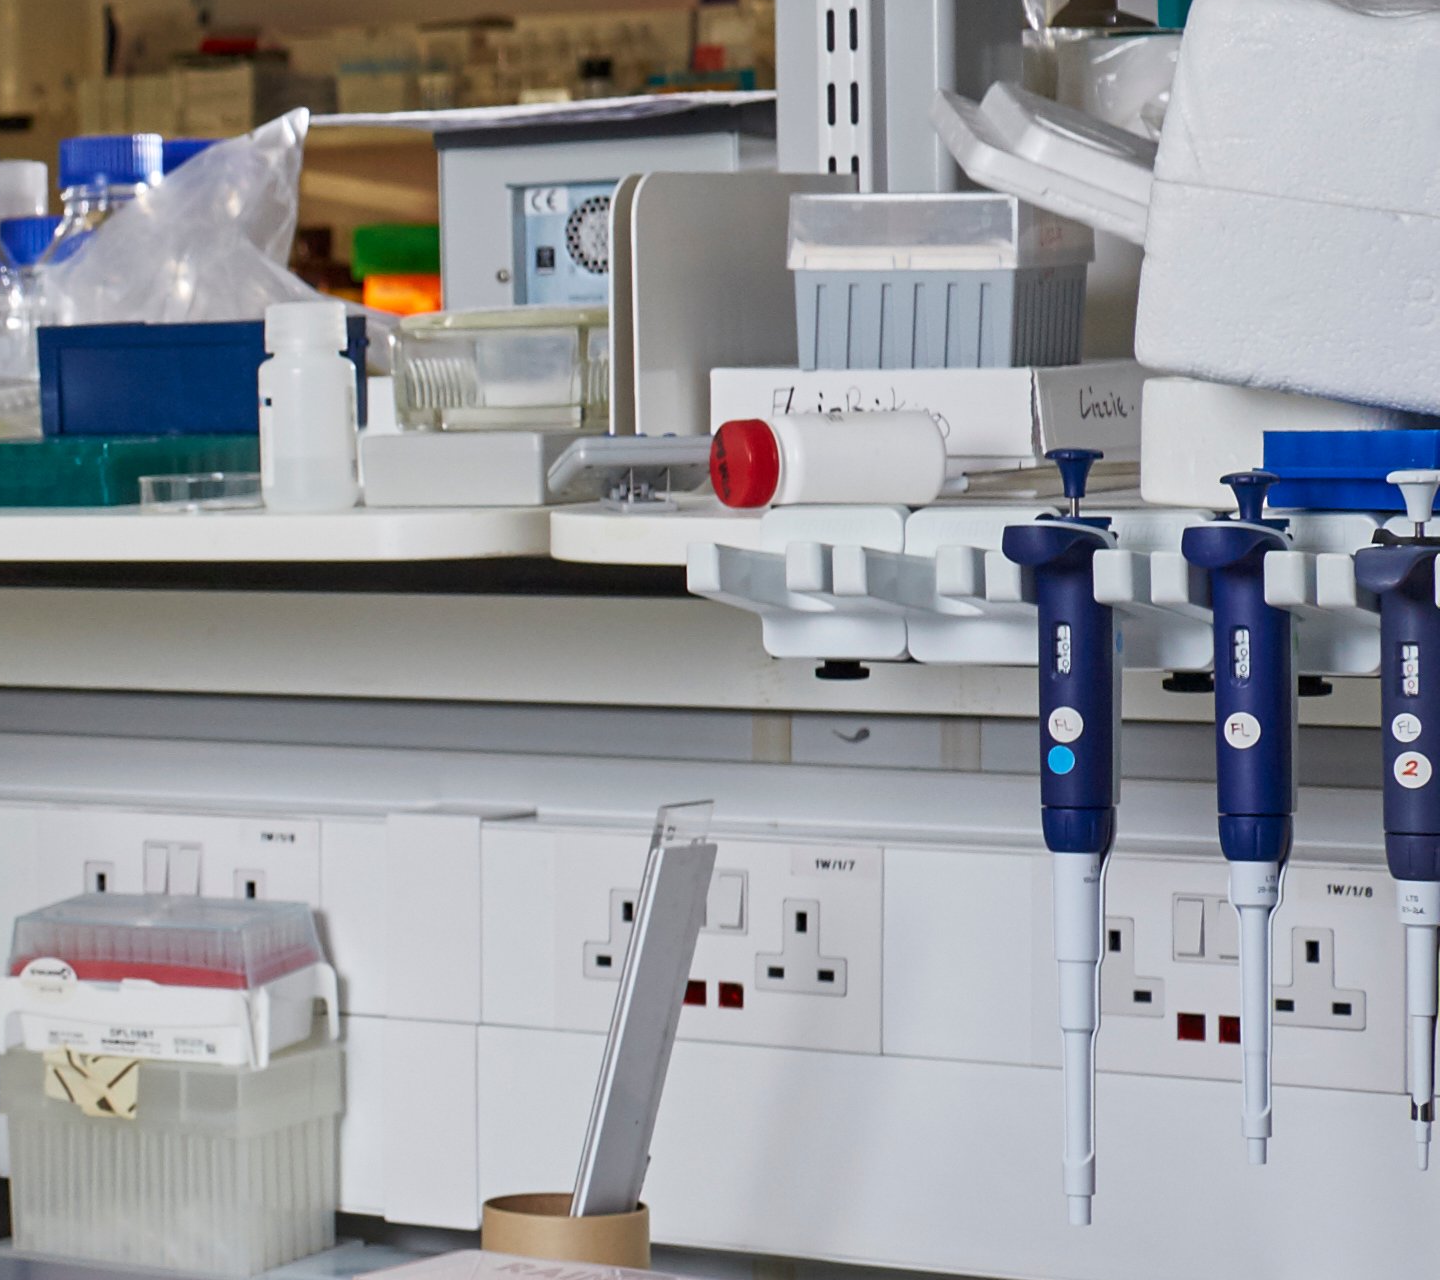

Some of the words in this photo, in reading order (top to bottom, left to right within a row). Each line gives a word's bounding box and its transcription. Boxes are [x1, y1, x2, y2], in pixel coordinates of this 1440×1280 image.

[1054, 718, 1073, 733] FL
[1231, 723, 1249, 737] FL
[1396, 719, 1418, 734] FL
[1403, 760, 1418, 777] 2
[815, 858, 856, 871] 1W/1/7
[1326, 883, 1373, 898] 1W/1/8
